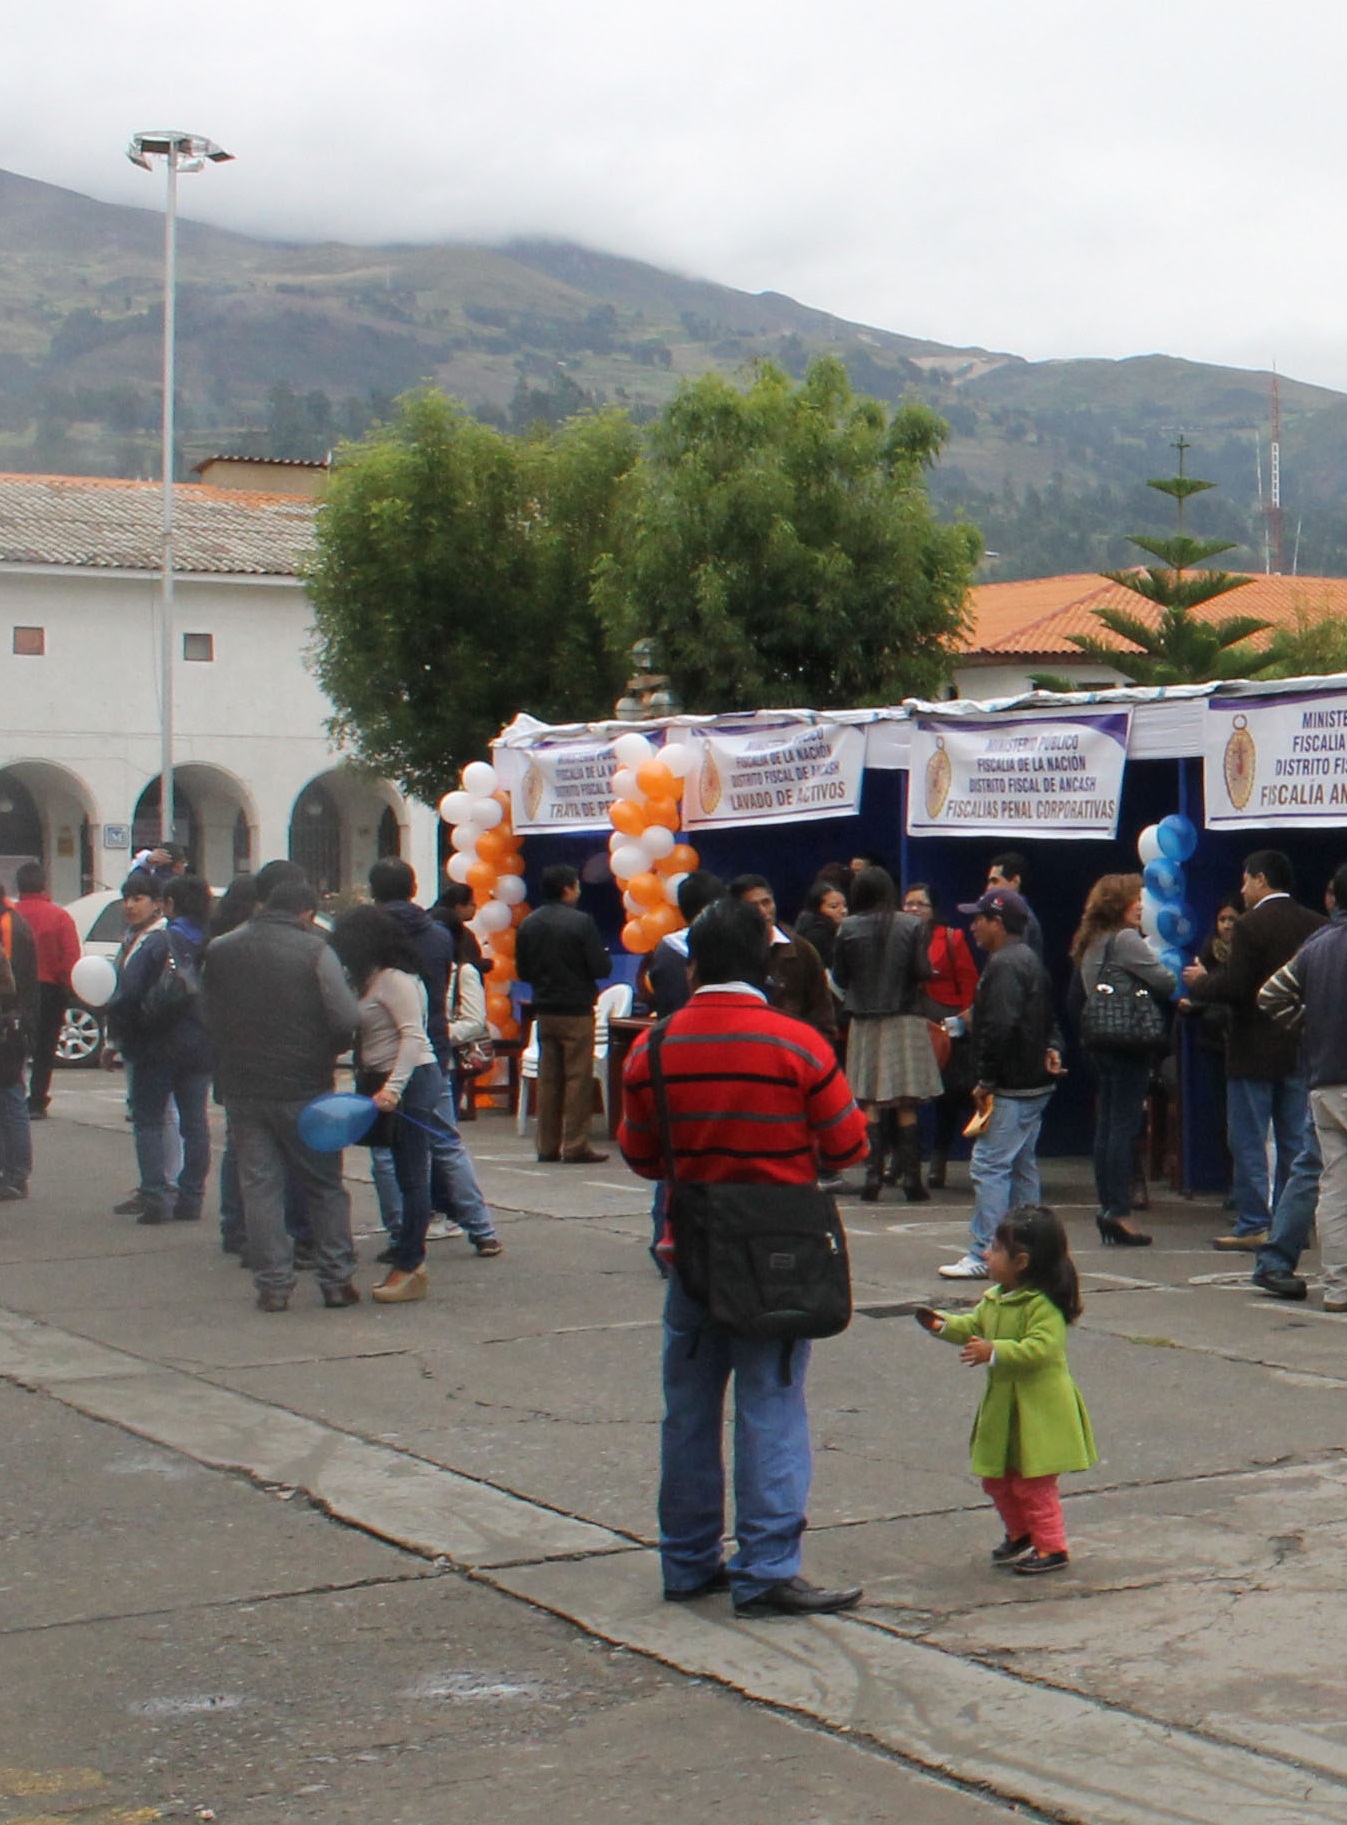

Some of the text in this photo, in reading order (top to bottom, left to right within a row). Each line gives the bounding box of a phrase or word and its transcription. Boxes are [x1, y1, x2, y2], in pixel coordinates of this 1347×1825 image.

[770, 752, 781, 765] DE
[784, 750, 795, 763] LA
[1017, 757, 1030, 772] DE
[1032, 757, 1045, 772] LA
[1047, 752, 1086, 771] NACIÓN
[1275, 757, 1330, 776] DISTRITO
[765, 769, 796, 785] FISCAL
[797, 766, 809, 780] DE
[969, 776, 1096, 793] DISTRITO FISCAL DE ANCASH
[729, 791, 772, 811] LAVADO
[775, 788, 793, 806] DE
[1260, 778, 1324, 806] FISCALÍA
[1001, 800, 1033, 819] PENAL
[1037, 799, 1115, 819] CORPORATIVAS
